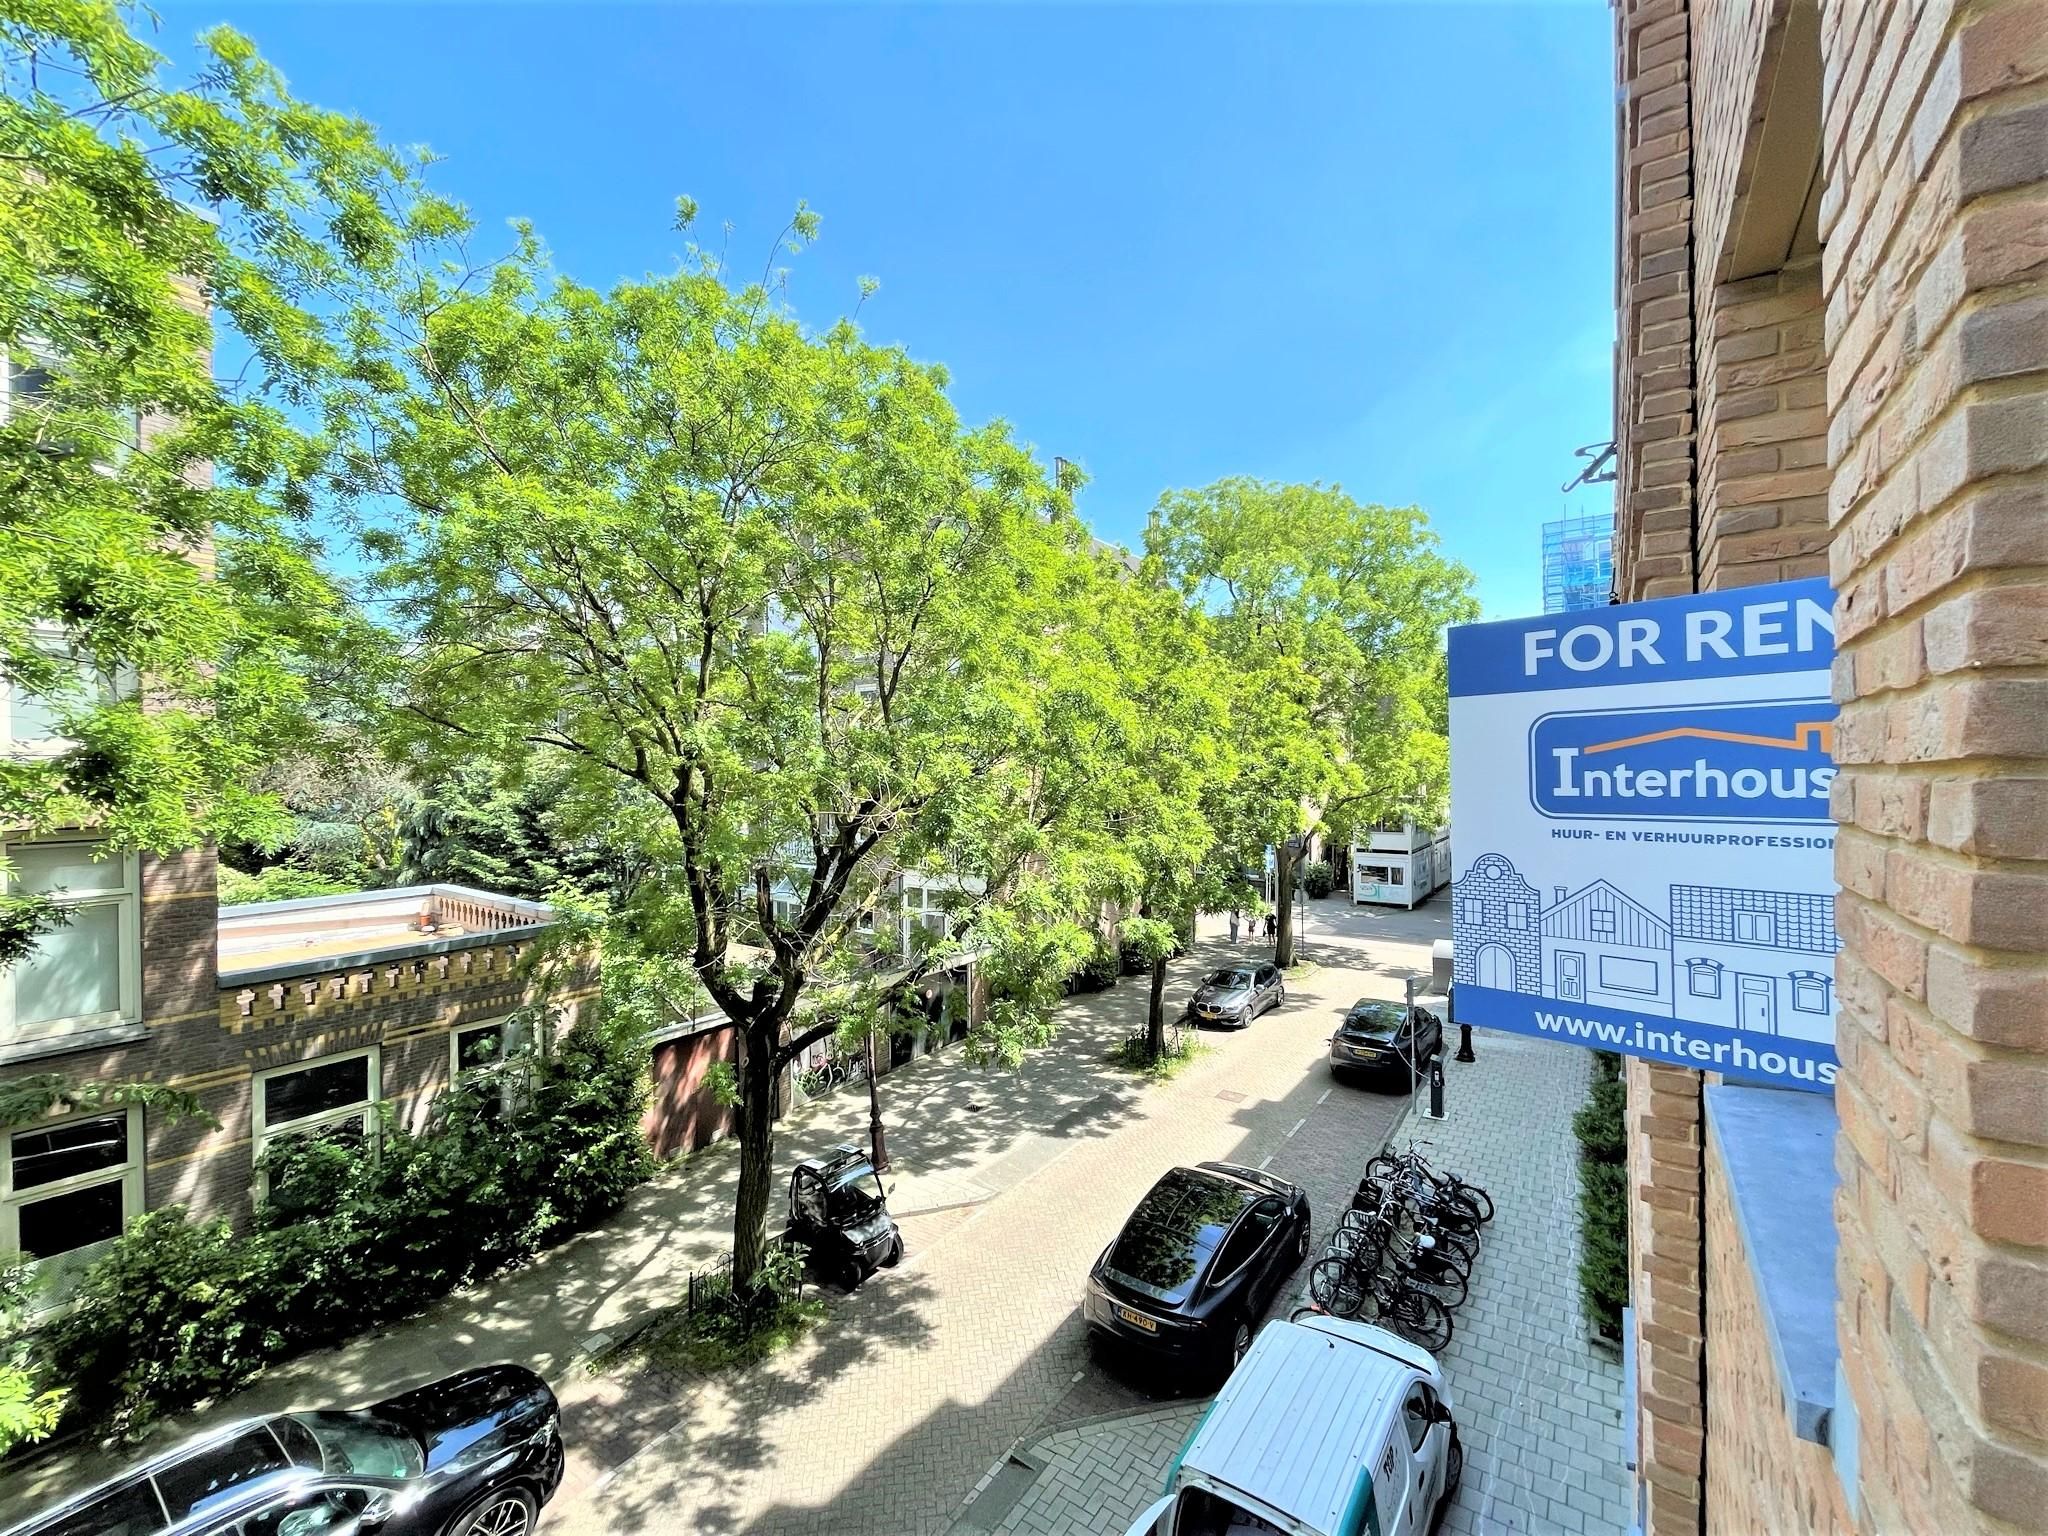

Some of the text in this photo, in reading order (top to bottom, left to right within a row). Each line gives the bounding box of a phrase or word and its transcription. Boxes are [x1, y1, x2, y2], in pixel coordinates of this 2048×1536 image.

[1524, 618, 1665, 676] FOR
[1552, 747, 1838, 799] Interhous
[1551, 828, 1600, 840] HUUR-
[1605, 830, 1626, 841] EN
[1535, 1011, 1838, 1085] www.interhous
